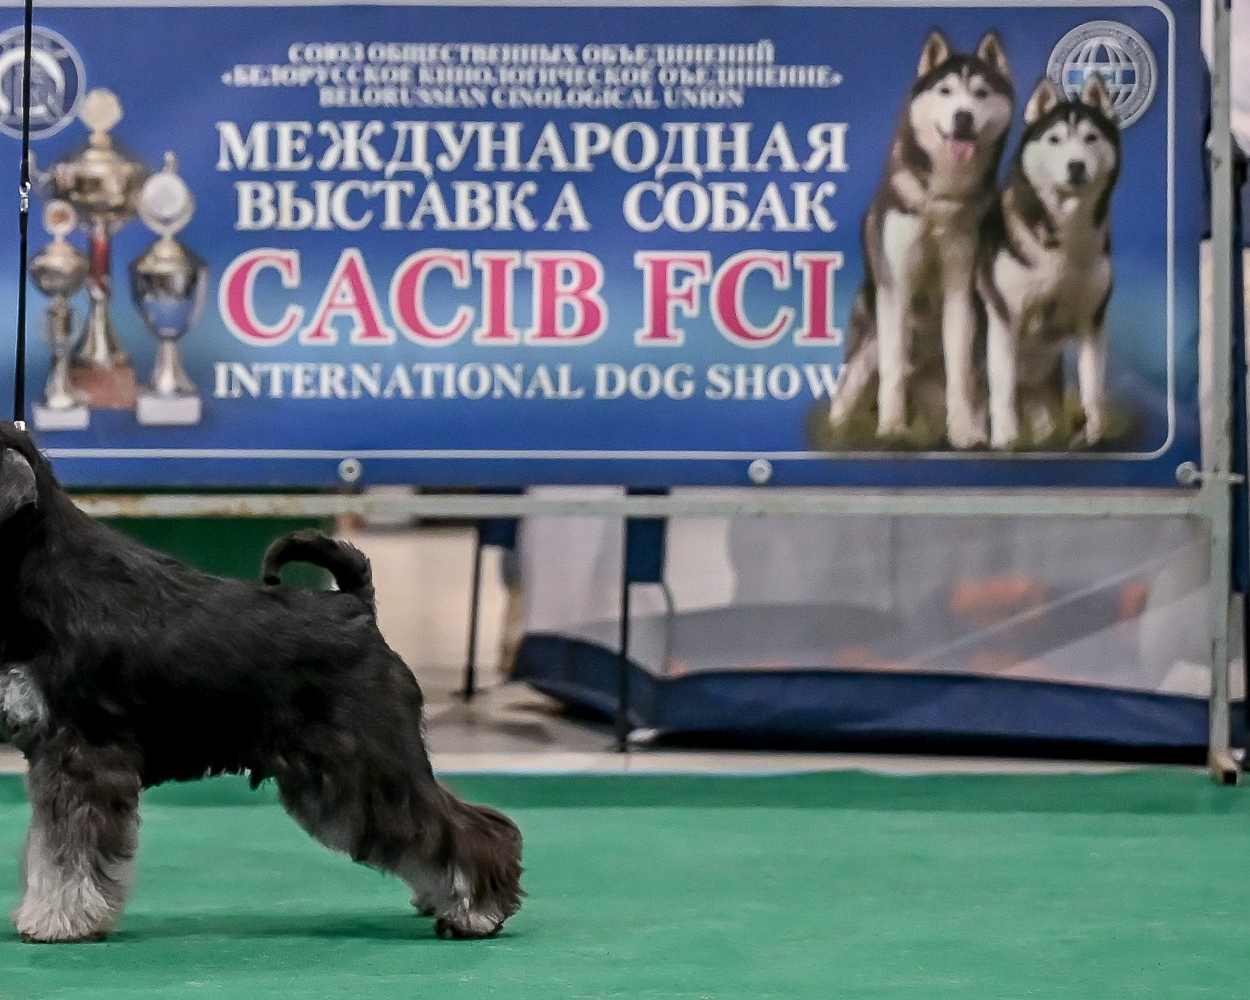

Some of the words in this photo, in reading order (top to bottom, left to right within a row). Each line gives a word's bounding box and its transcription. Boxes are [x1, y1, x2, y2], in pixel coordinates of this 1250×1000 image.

[663, 86, 745, 109] UNION
[216, 121, 850, 180] МЕЖДУНАРОДНАЯ
[234, 180, 592, 232] ВЫСТАВКА
[623, 180, 838, 233] СОБАК
[219, 247, 608, 348] CACIB
[634, 248, 844, 348] FCI
[213, 361, 585, 400] INTERNATIONAL
[594, 362, 696, 400] DOG
